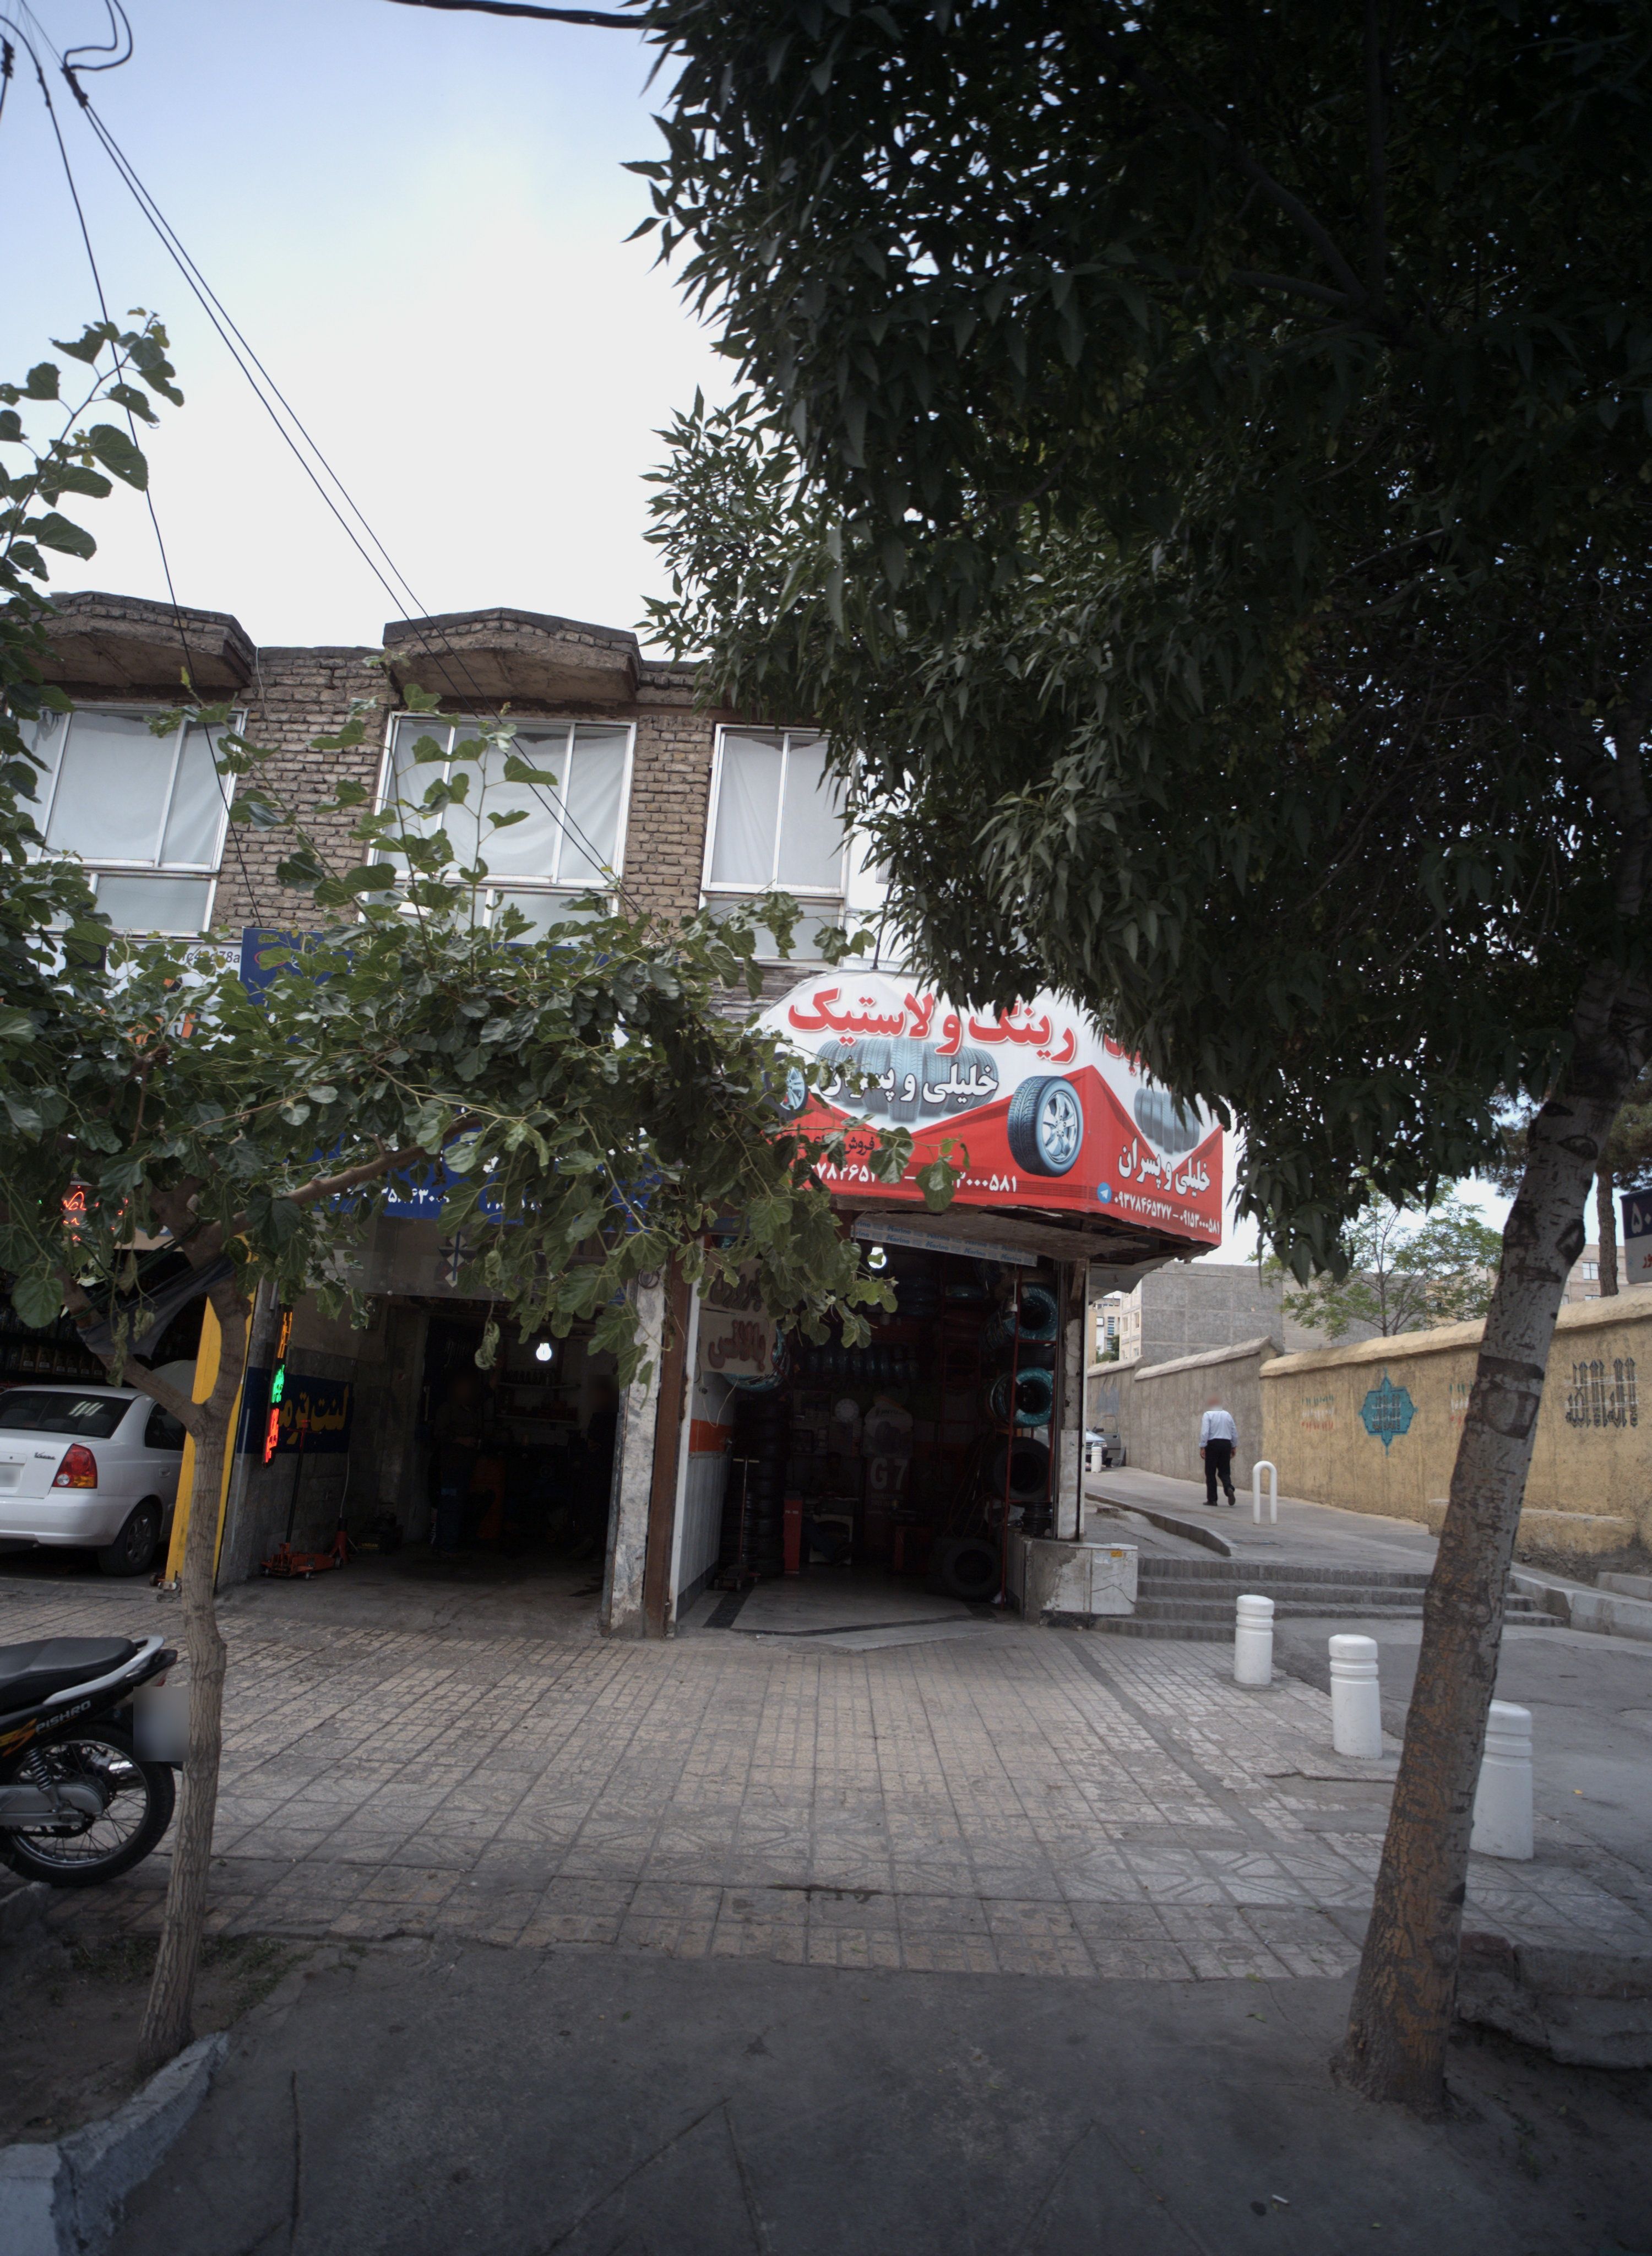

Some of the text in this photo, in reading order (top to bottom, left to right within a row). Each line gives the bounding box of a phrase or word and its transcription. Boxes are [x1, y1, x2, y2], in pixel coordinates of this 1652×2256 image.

[788, 988, 934, 1046] لاستیک
[934, 1014, 962, 1055] و
[900, 1073, 916, 1102] و
[922, 1062, 999, 1103] خلیلی
[1118, 1136, 1210, 1197] خلیلی و پسران
[278, 1392, 310, 1445] ترم
[35, 1700, 91, 1733] PISHRO
